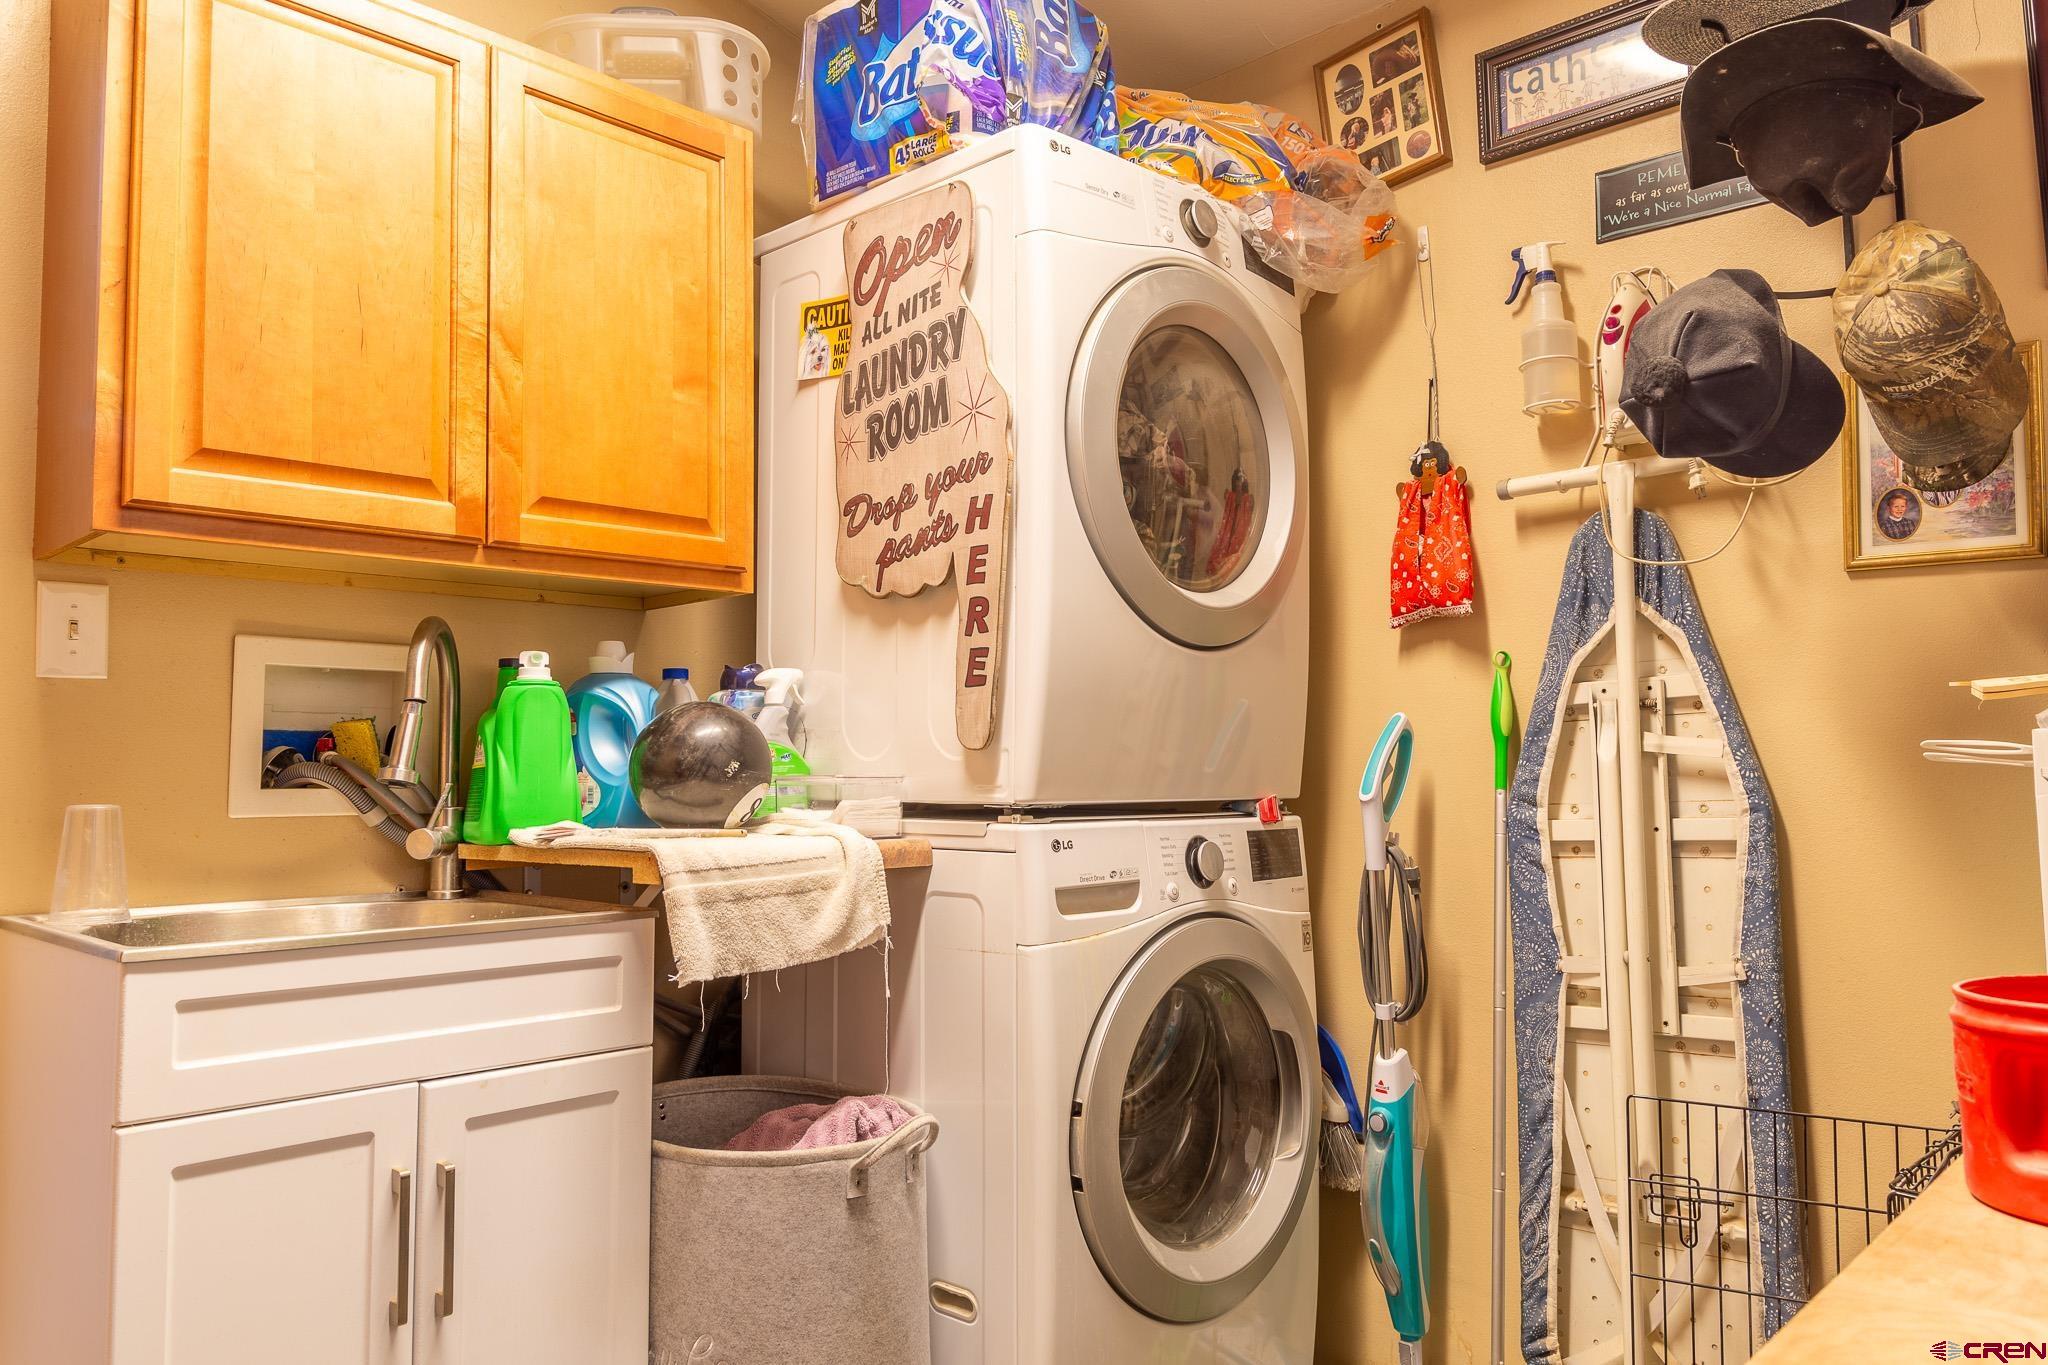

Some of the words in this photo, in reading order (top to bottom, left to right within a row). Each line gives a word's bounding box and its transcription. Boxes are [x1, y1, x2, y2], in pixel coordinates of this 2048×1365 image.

[857, 46, 922, 126] Bat
[895, 143, 910, 166] 45
[911, 133, 938, 149] LARGE
[1281, 136, 1305, 154] 150
[1638, 162, 1685, 186] REME
[1615, 196, 1626, 207] as
[1630, 190, 1647, 203] far
[1650, 188, 1661, 199] as
[1643, 207, 1651, 217] a
[1655, 200, 1682, 216] Nice
[1686, 187, 1732, 208] Normal
[854, 211, 962, 317] Open
[862, 310, 892, 347] ALL
[898, 281, 942, 327] NITE
[837, 327, 850, 342] KIL
[832, 357, 845, 370] ON
[842, 306, 968, 416] LAUNDRY
[1882, 365, 1954, 393] INTERSTATE
[866, 377, 950, 462] ROOM
[844, 483, 918, 537] Drop
[925, 451, 994, 514] your
[876, 510, 958, 592] pants
[965, 494, 993, 688] HERE
[740, 798, 762, 822] 8
[1079, 875, 1093, 883] Direct
[1094, 874, 1105, 882] Drive
